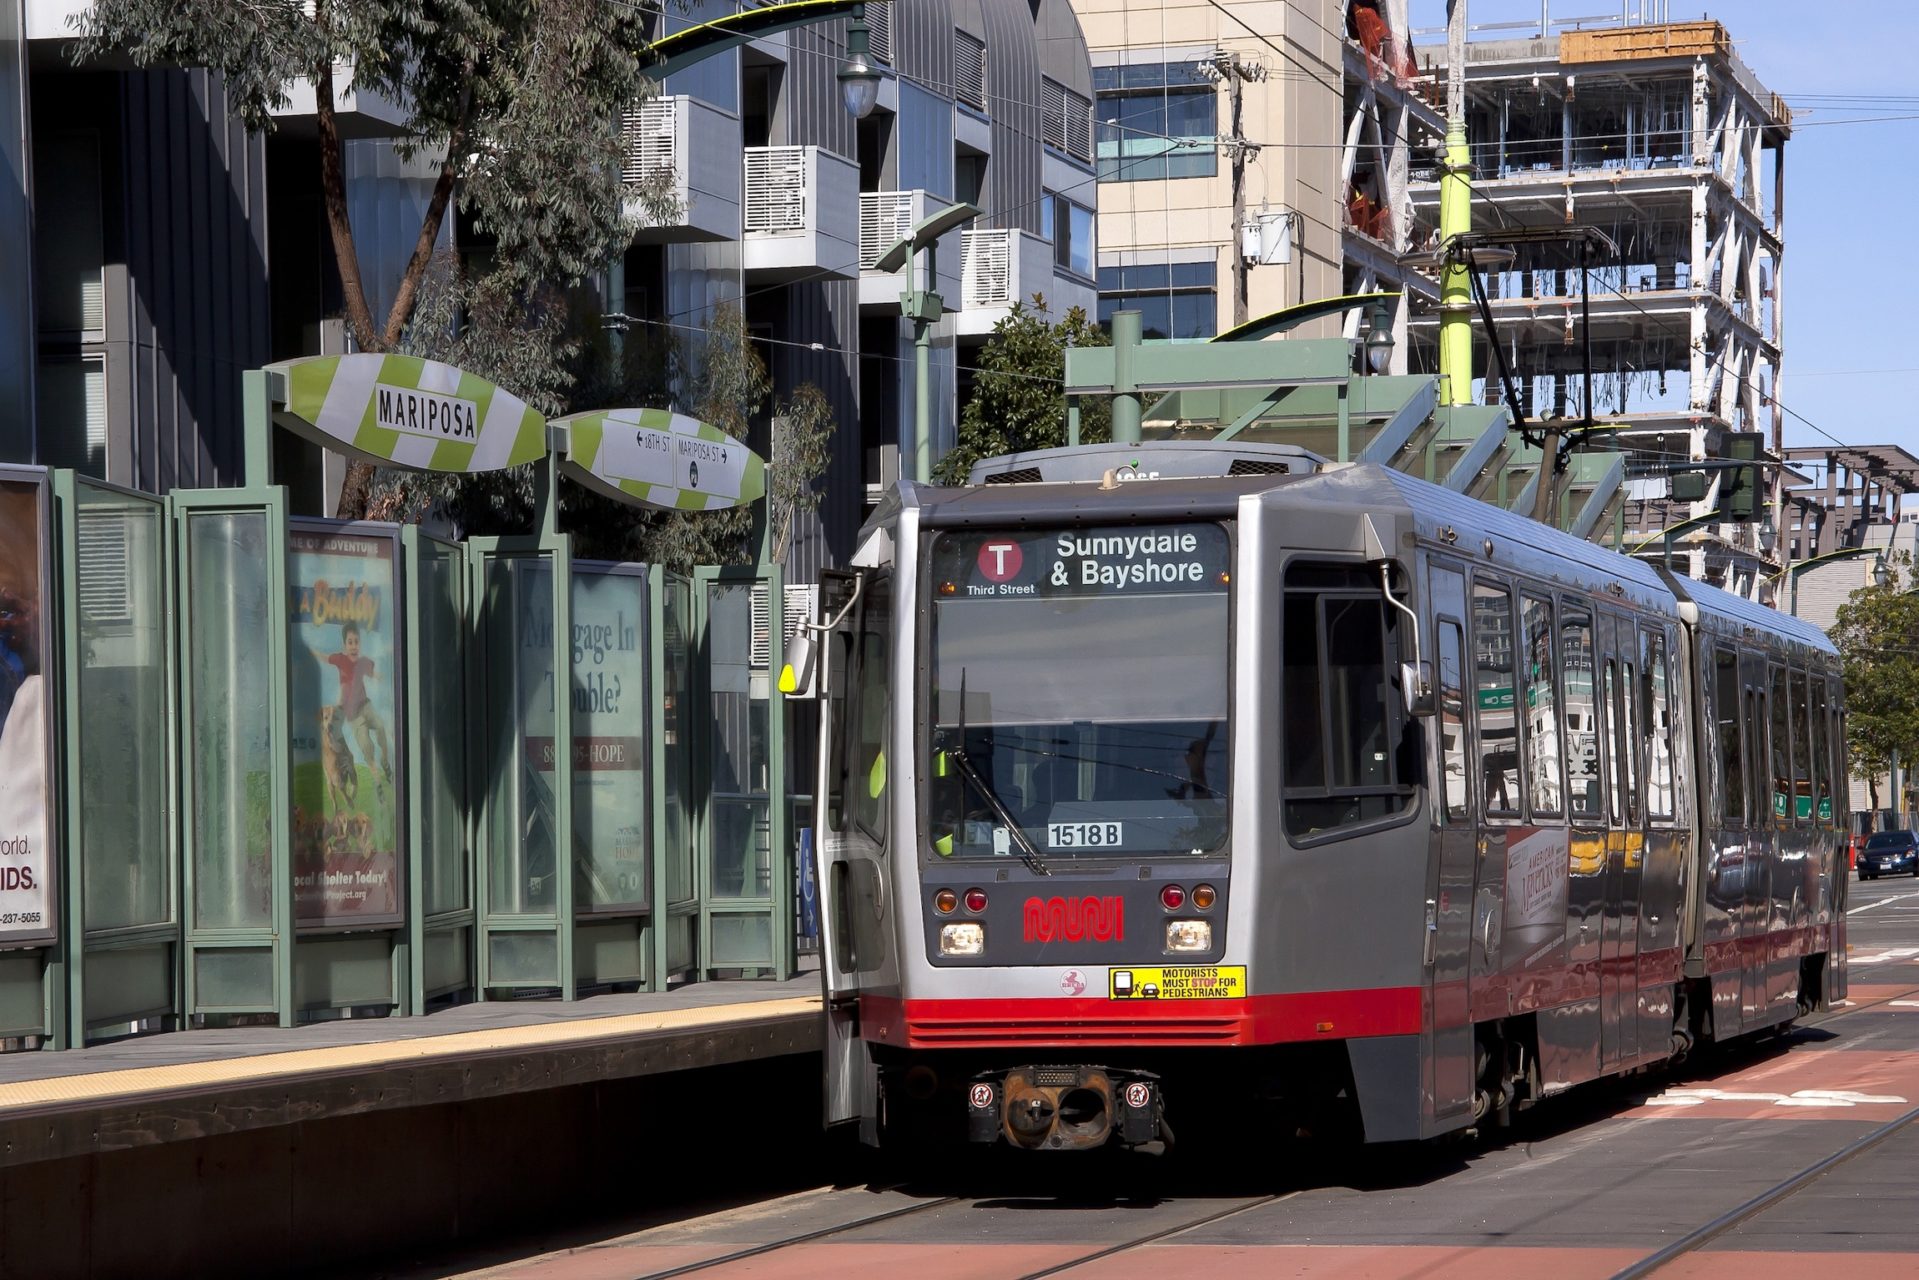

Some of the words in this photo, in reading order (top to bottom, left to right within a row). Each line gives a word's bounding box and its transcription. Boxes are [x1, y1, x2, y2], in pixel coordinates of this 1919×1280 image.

[378, 389, 475, 439] MARIPOSA
[645, 433, 660, 451] 18TH
[662, 435, 670, 453] ST
[678, 439, 710, 461] MARIPOSA
[712, 446, 719, 463] ST
[324, 539, 379, 554] ADVENTURE
[1057, 529, 1197, 560] Sunnydale
[988, 544, 1012, 576] T
[1050, 560, 1069, 587] &
[1081, 557, 1204, 589] Bayshore
[967, 584, 995, 596] Third
[999, 583, 1036, 596] Street
[617, 610, 635, 651] In
[0, 834, 31, 856] orld.
[294, 871, 315, 887] ocal
[317, 870, 353, 886] Shelter
[355, 869, 387, 888] Today!
[1162, 968, 1218, 978] MOTORISTS
[1162, 978, 1190, 988] MUST
[1191, 978, 1217, 988] STOP
[1219, 977, 1237, 987] FOR
[1162, 987, 1229, 998] PEDESTRIANS
